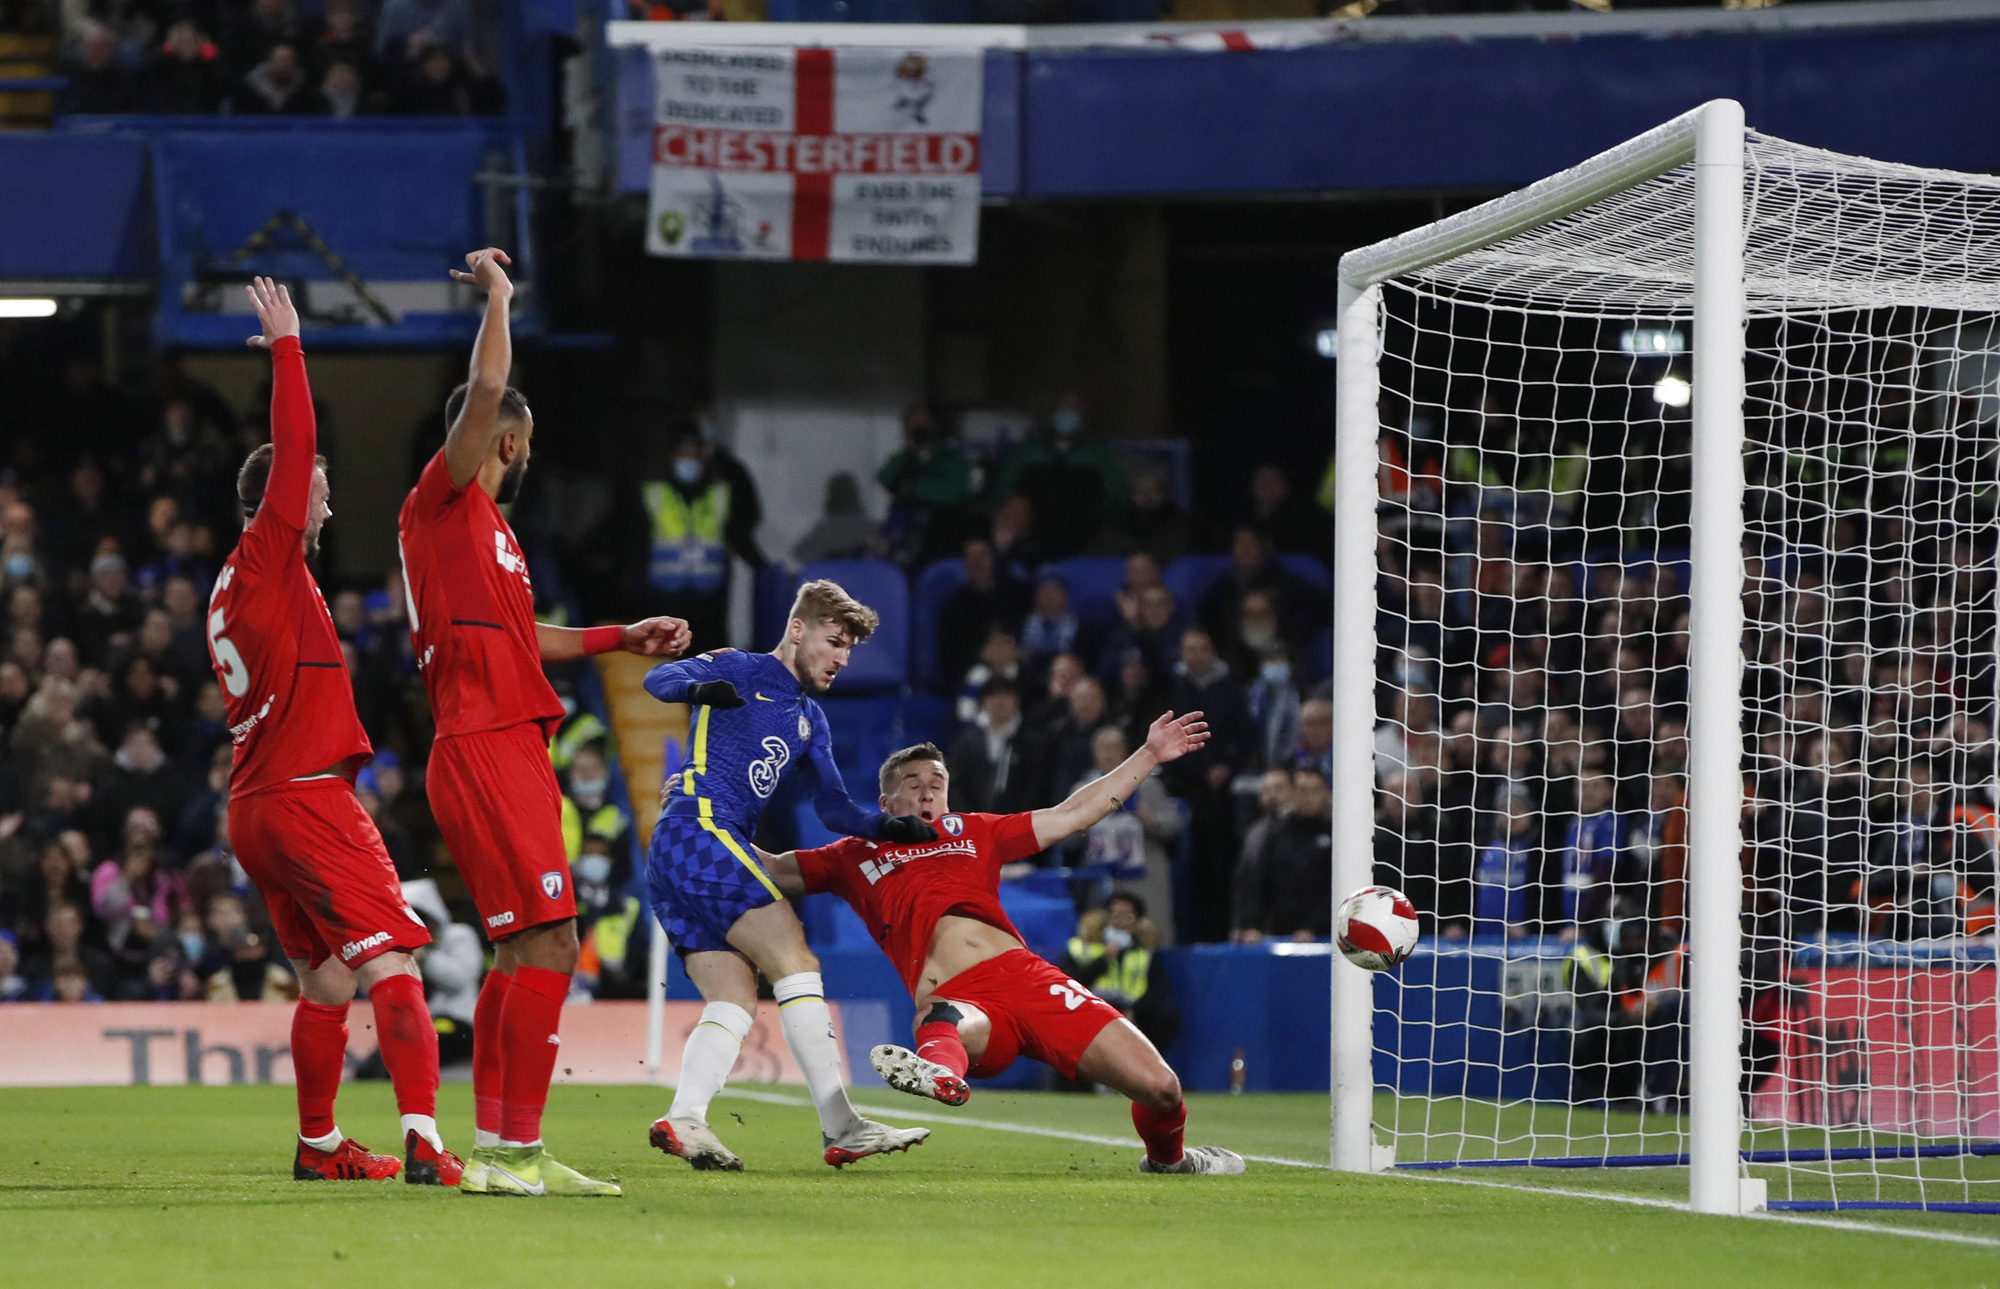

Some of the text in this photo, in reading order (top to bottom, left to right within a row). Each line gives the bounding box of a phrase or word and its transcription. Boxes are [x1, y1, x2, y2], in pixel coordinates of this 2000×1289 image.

[684, 74, 715, 95] TO
[664, 100, 785, 125] DEDICATED
[659, 126, 974, 172] CHESTERFIELD
[208, 606, 250, 698] 5
